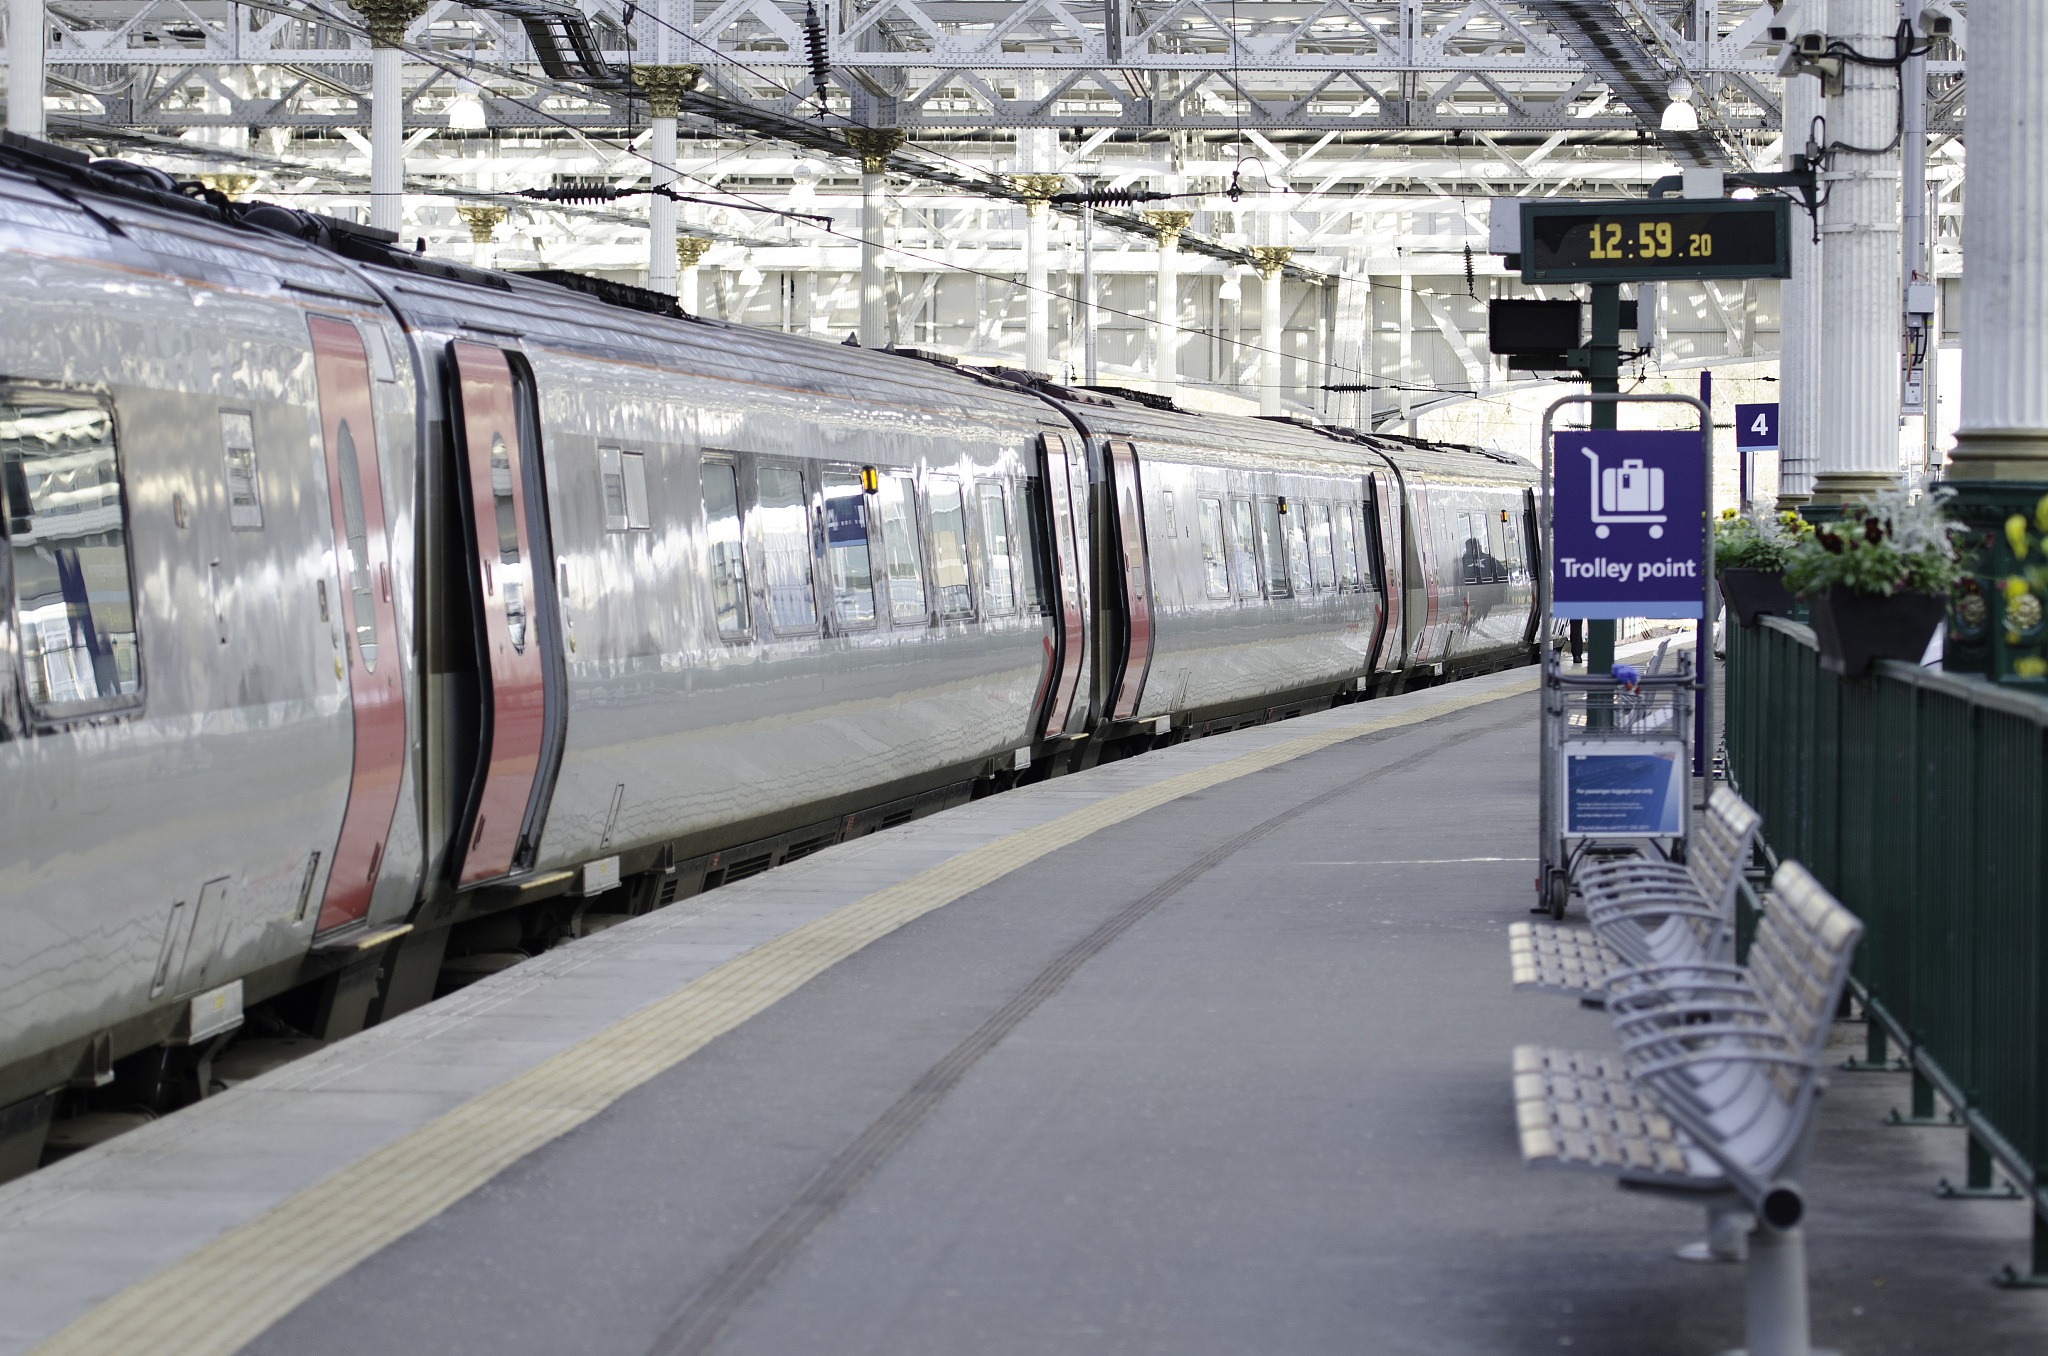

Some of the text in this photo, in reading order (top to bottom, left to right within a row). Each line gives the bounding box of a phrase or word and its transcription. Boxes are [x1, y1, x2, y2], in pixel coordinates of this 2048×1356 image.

[1751, 413, 1769, 436] 4
[1560, 557, 1697, 583] Trolley point
